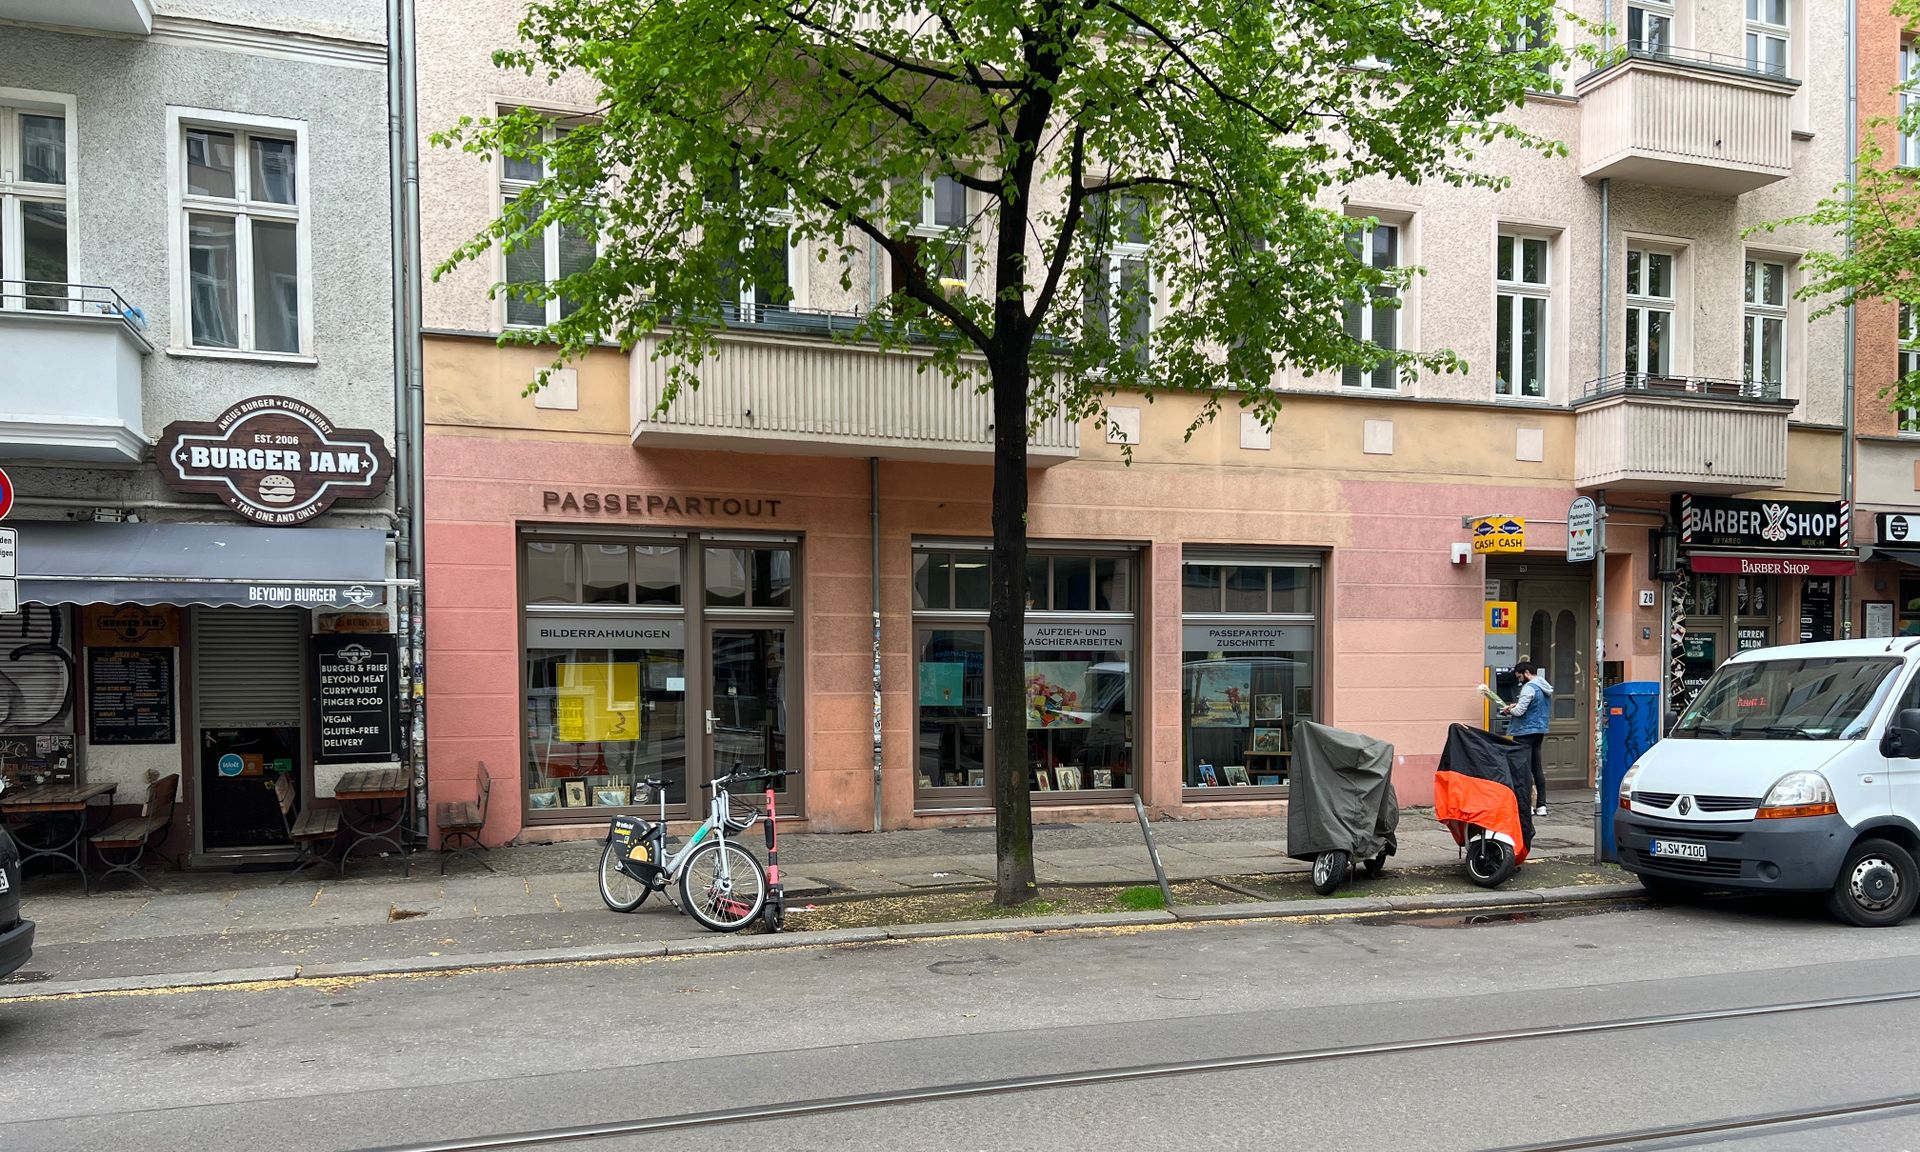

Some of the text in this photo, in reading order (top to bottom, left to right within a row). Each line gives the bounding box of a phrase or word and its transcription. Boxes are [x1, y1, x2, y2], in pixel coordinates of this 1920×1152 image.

[218, 399, 333, 435] ANGUS BURGER CURRYWURST
[254, 434, 299, 445] EST. 2006
[190, 446, 360, 474] BURGER JAM
[542, 490, 782, 518] PASSEPARTOUT
[236, 502, 318, 523] THE ONE AND ONLY
[1691, 507, 1838, 537] BARBER SHOP
[1474, 538, 1522, 550] CASH CASH
[1741, 559, 1810, 575] BARBER SHOP
[249, 586, 292, 602] BEYOND
[294, 587, 337, 602] BURGER
[1643, 592, 1653, 604] 28
[540, 629, 671, 639] BILDERRAHMUNGEN
[1036, 628, 1107, 636] AUFZIEH- UND
[1209, 629, 1285, 637] PASSEPARTOUT-
[1738, 630, 1765, 639] HERREN
[1216, 639, 1276, 647] ZUSCHNITTE
[1740, 639, 1762, 649] SALON
[321, 663, 388, 673] BURGER & FRIES
[322, 674, 385, 684] BEYOND MEAT
[322, 686, 378, 695] CURRYWURST
[323, 697, 384, 706] FINGER FOOD
[323, 715, 352, 723] VEGAN
[323, 726, 380, 736] GLUTEN-FREE
[324, 738, 364, 747] DELIVERY
[1656, 841, 1662, 853] B
[1681, 844, 1705, 857] 7100
